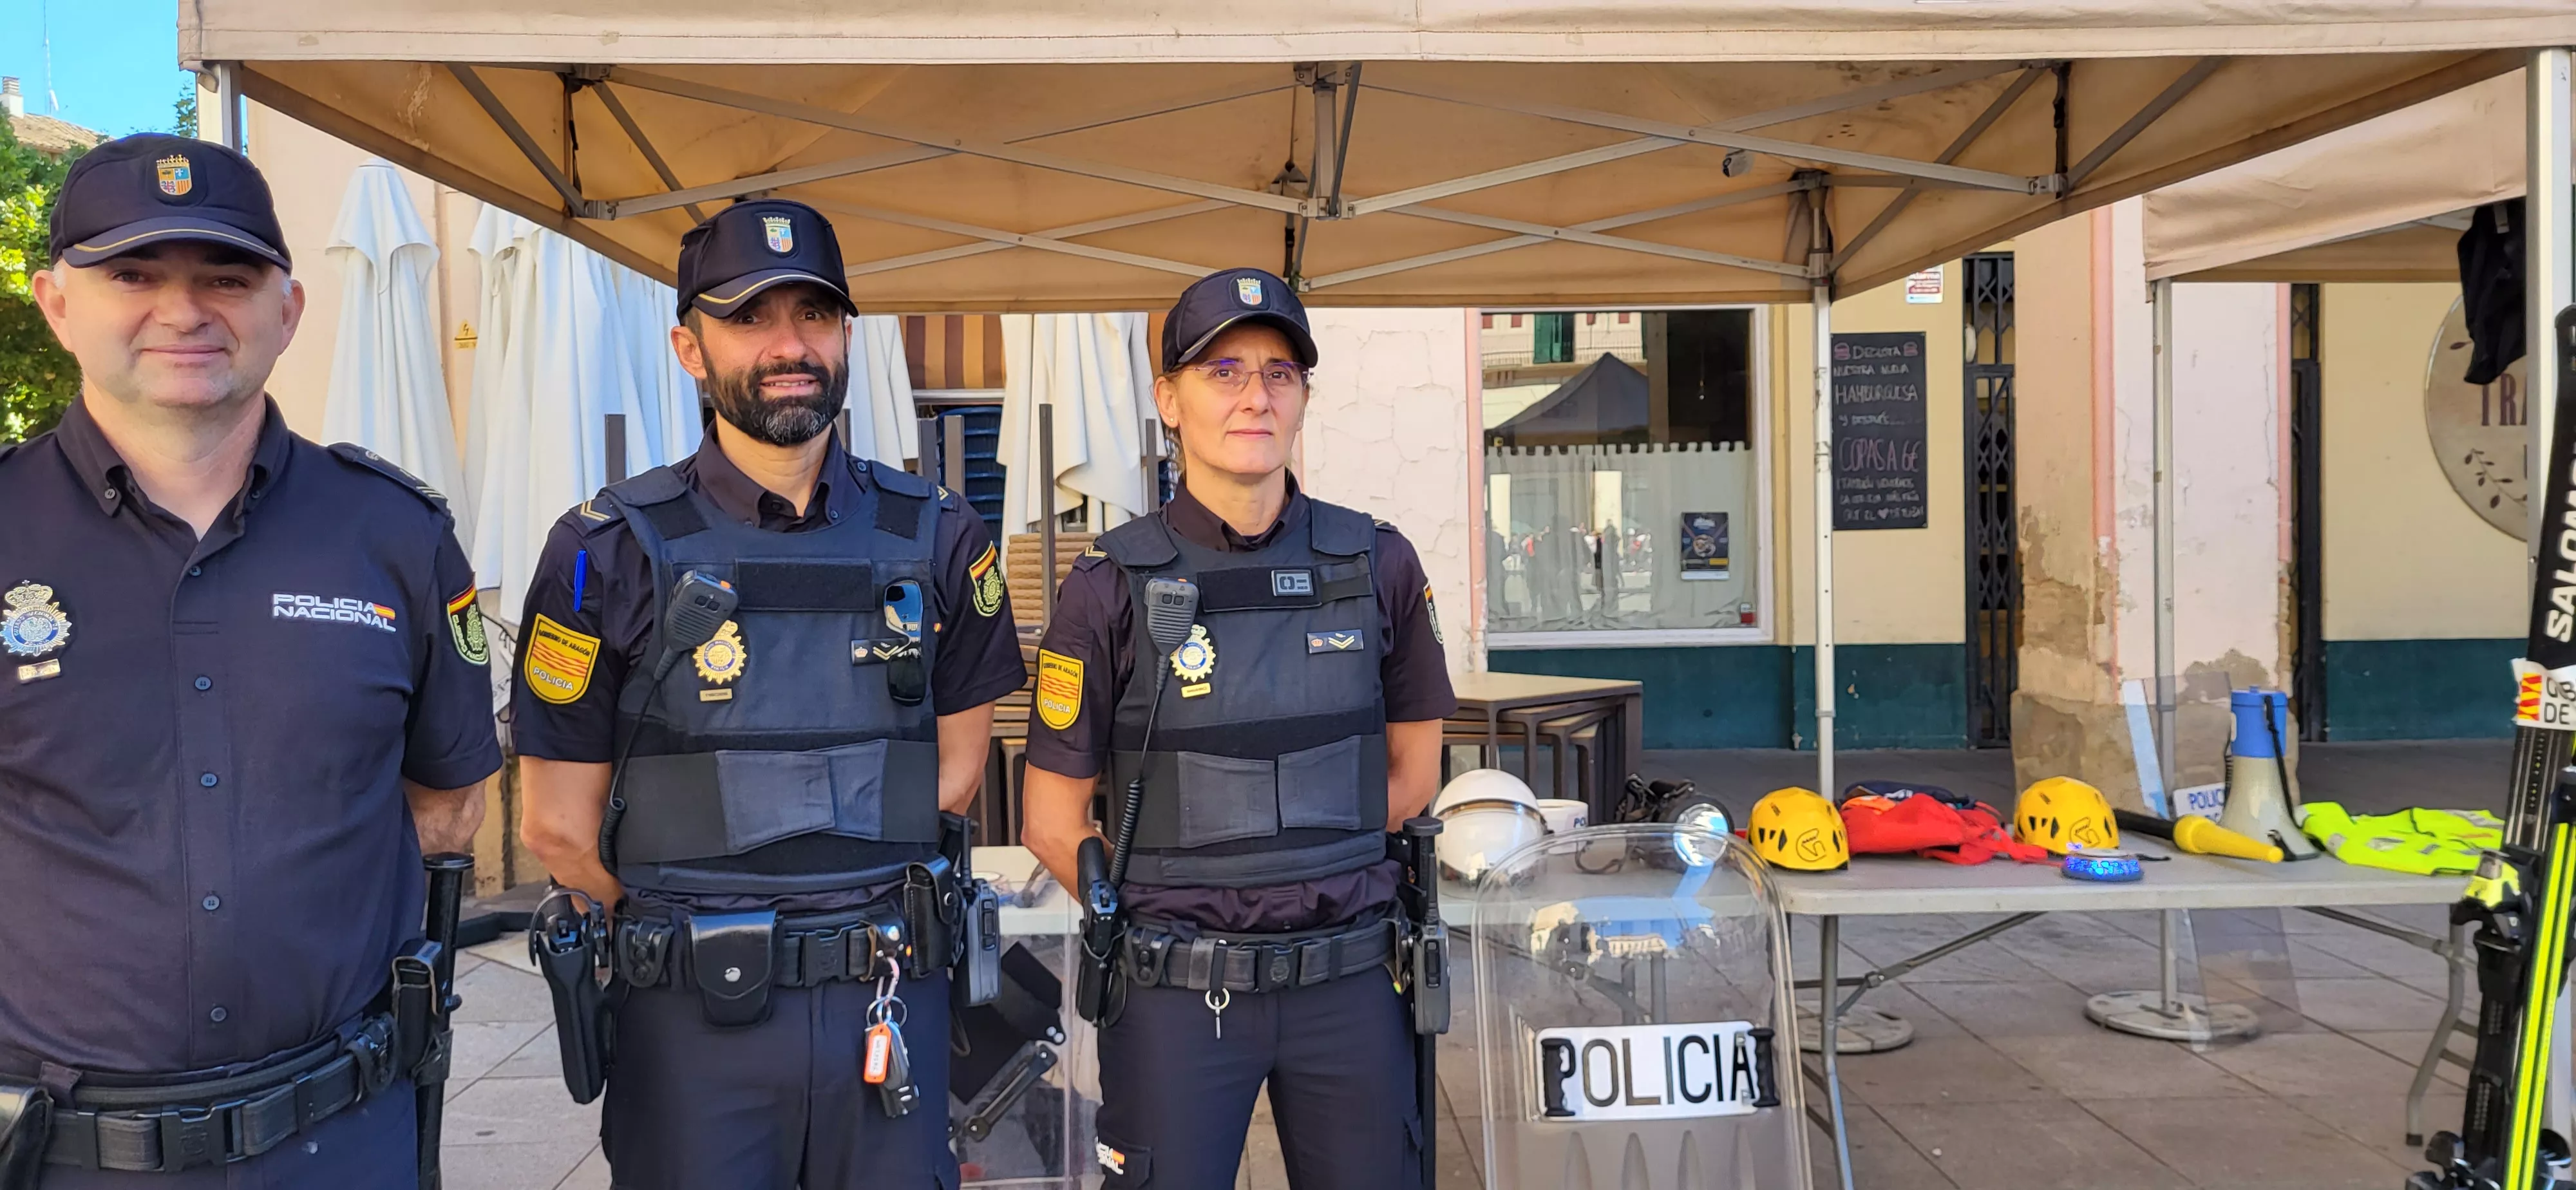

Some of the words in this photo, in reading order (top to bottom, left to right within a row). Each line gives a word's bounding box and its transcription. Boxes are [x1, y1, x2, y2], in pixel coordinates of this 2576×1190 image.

[1839, 437, 1886, 471] COPAS
[273, 594, 377, 614] POLICIA
[274, 606, 397, 632] NACIONAL
[533, 666, 574, 690] POLICIA
[1044, 698, 1070, 713] POLICIA
[2544, 702, 2570, 725] DE
